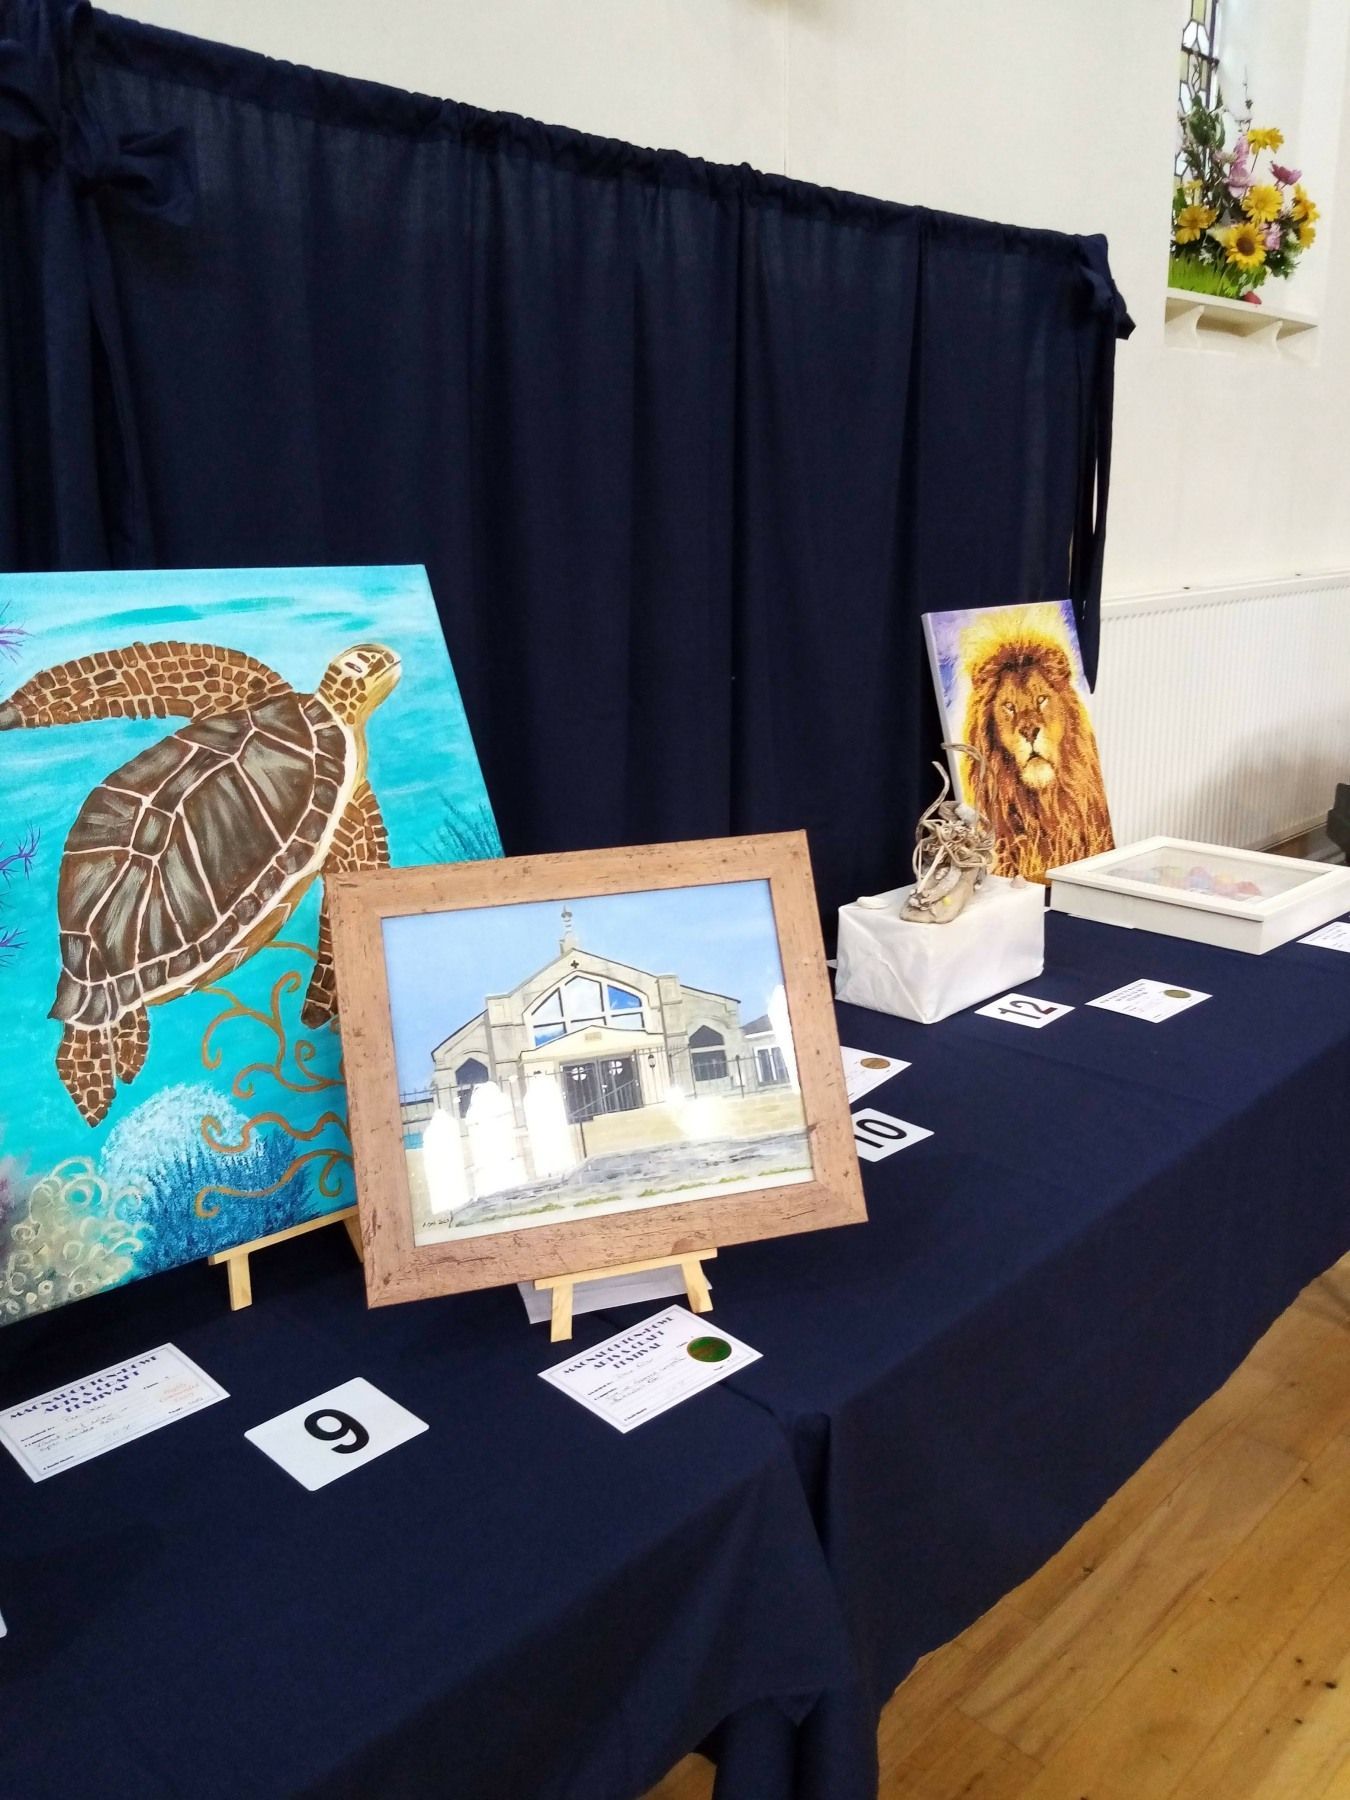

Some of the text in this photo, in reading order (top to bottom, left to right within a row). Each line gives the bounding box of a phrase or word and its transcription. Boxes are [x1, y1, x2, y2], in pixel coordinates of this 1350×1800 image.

[998, 1000, 1058, 1020] 12
[853, 1118, 907, 1149] 10
[612, 1342, 662, 1369] FESTIVAL
[65, 1383, 129, 1413] FESTIVAL
[304, 1409, 370, 1455] 9
